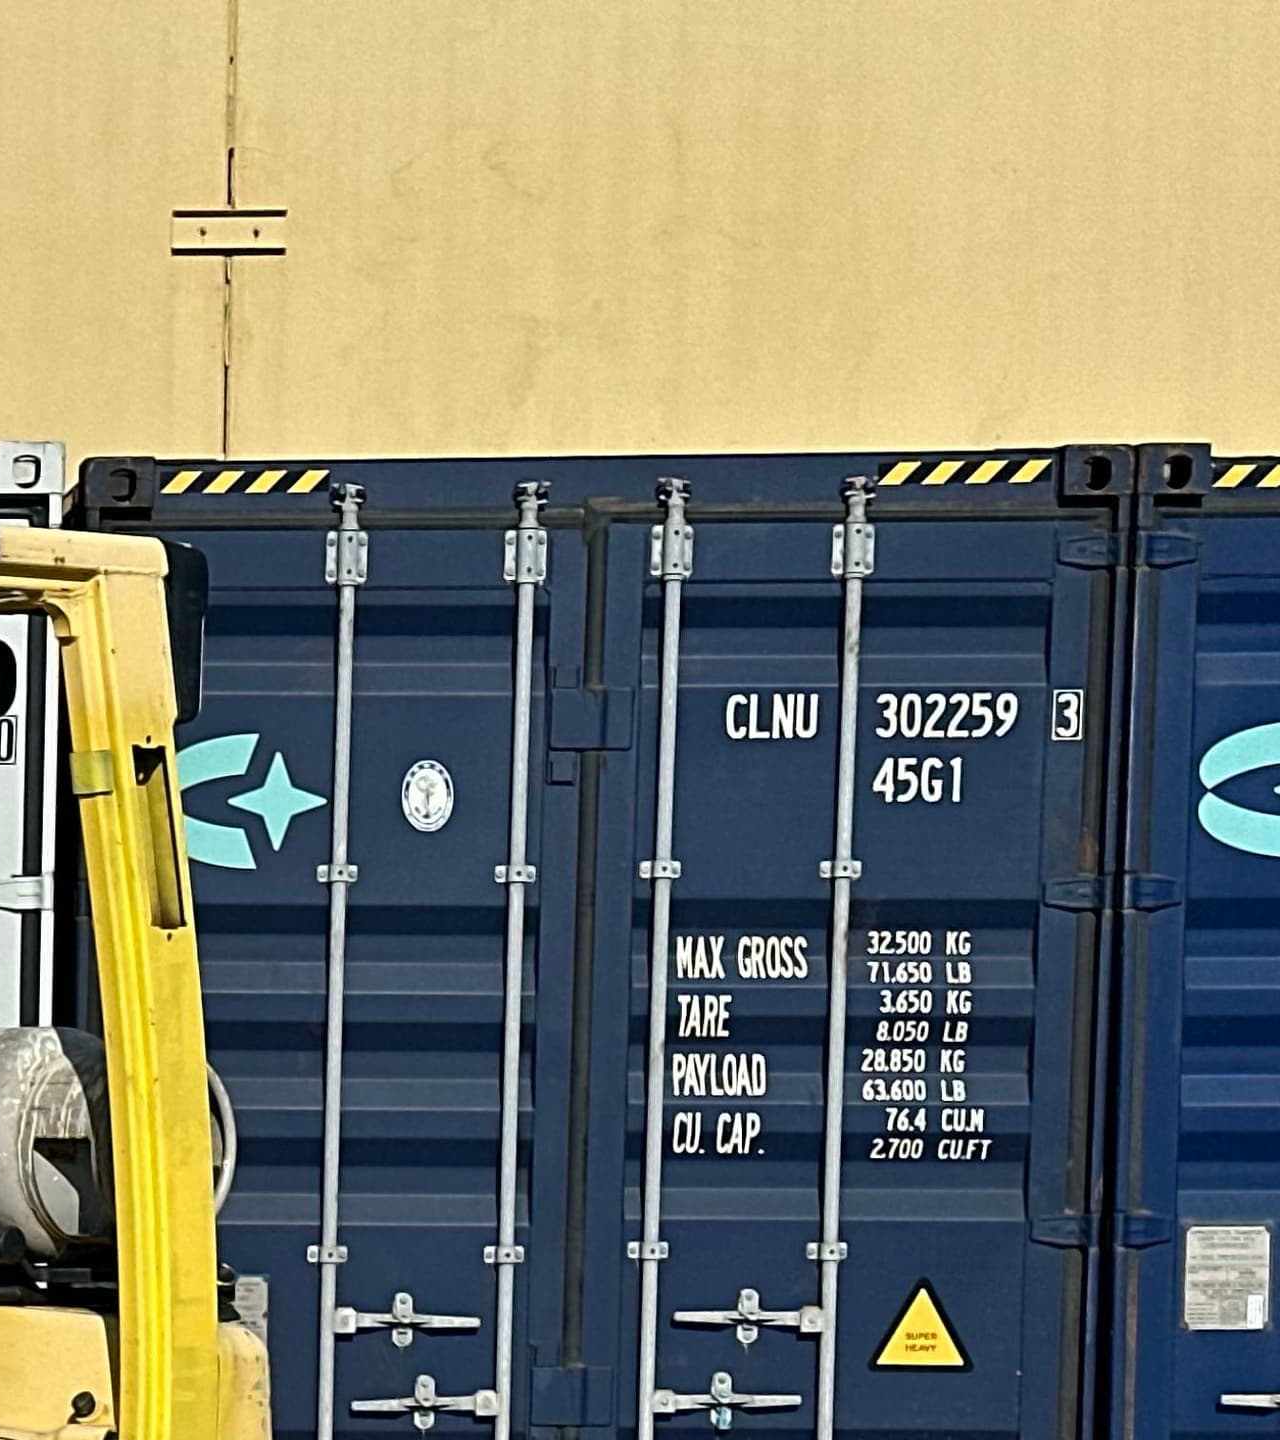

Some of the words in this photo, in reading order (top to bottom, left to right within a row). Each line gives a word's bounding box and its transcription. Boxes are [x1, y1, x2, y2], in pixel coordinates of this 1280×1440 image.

[725, 692, 820, 740] CLNU
[875, 691, 1019, 739] 302259
[1056, 692, 1080, 738] 3
[872, 756, 963, 803] 45G1
[866, 930, 932, 955] 32.500
[945, 931, 972, 956] KG
[676, 935, 726, 980] MAX
[737, 934, 809, 980] GROSS
[867, 961, 933, 984] 71.650
[945, 961, 973, 984] LB
[878, 989, 933, 1014] 3.650
[945, 990, 972, 1015] KG
[677, 994, 733, 1037] TARE
[875, 1020, 930, 1043] 8.050
[942, 1021, 969, 1043] LB
[860, 1048, 926, 1073] 28.850
[939, 1048, 966, 1073] KG
[672, 1053, 767, 1097] PAYLOAD
[861, 1078, 927, 1101] 63.600
[940, 1079, 967, 1102] LB
[884, 1107, 927, 1132] 76.4
[673, 1112, 705, 1155] CU.
[716, 1112, 766, 1155] CAP.
[869, 1138, 924, 1160] 2.700
[904, 1343, 937, 1353] HEAVY
[905, 1331, 938, 1341] SUPER
